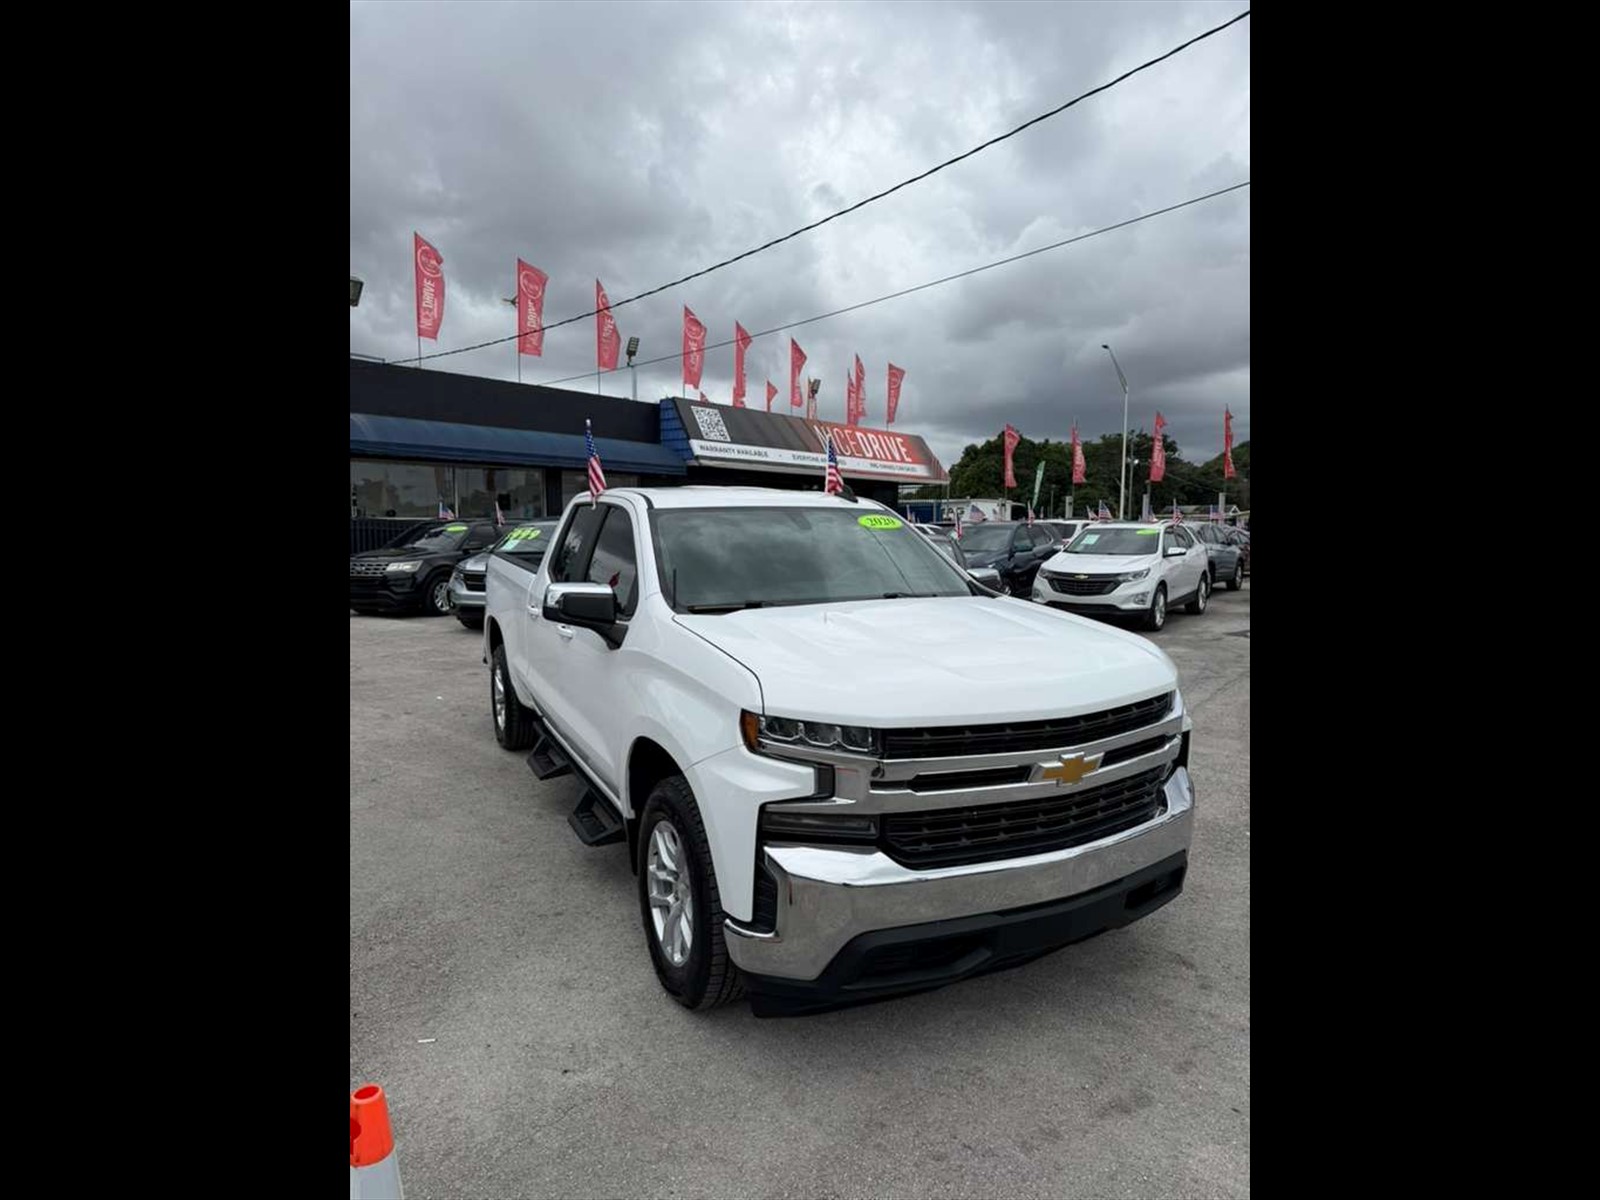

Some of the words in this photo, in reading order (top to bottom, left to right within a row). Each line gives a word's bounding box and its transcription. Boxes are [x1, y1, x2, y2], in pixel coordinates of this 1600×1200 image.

[699, 444, 735, 455] WARRANTY
[736, 448, 769, 459] AVAILABLE
[813, 424, 912, 462] NICEDRIVE
